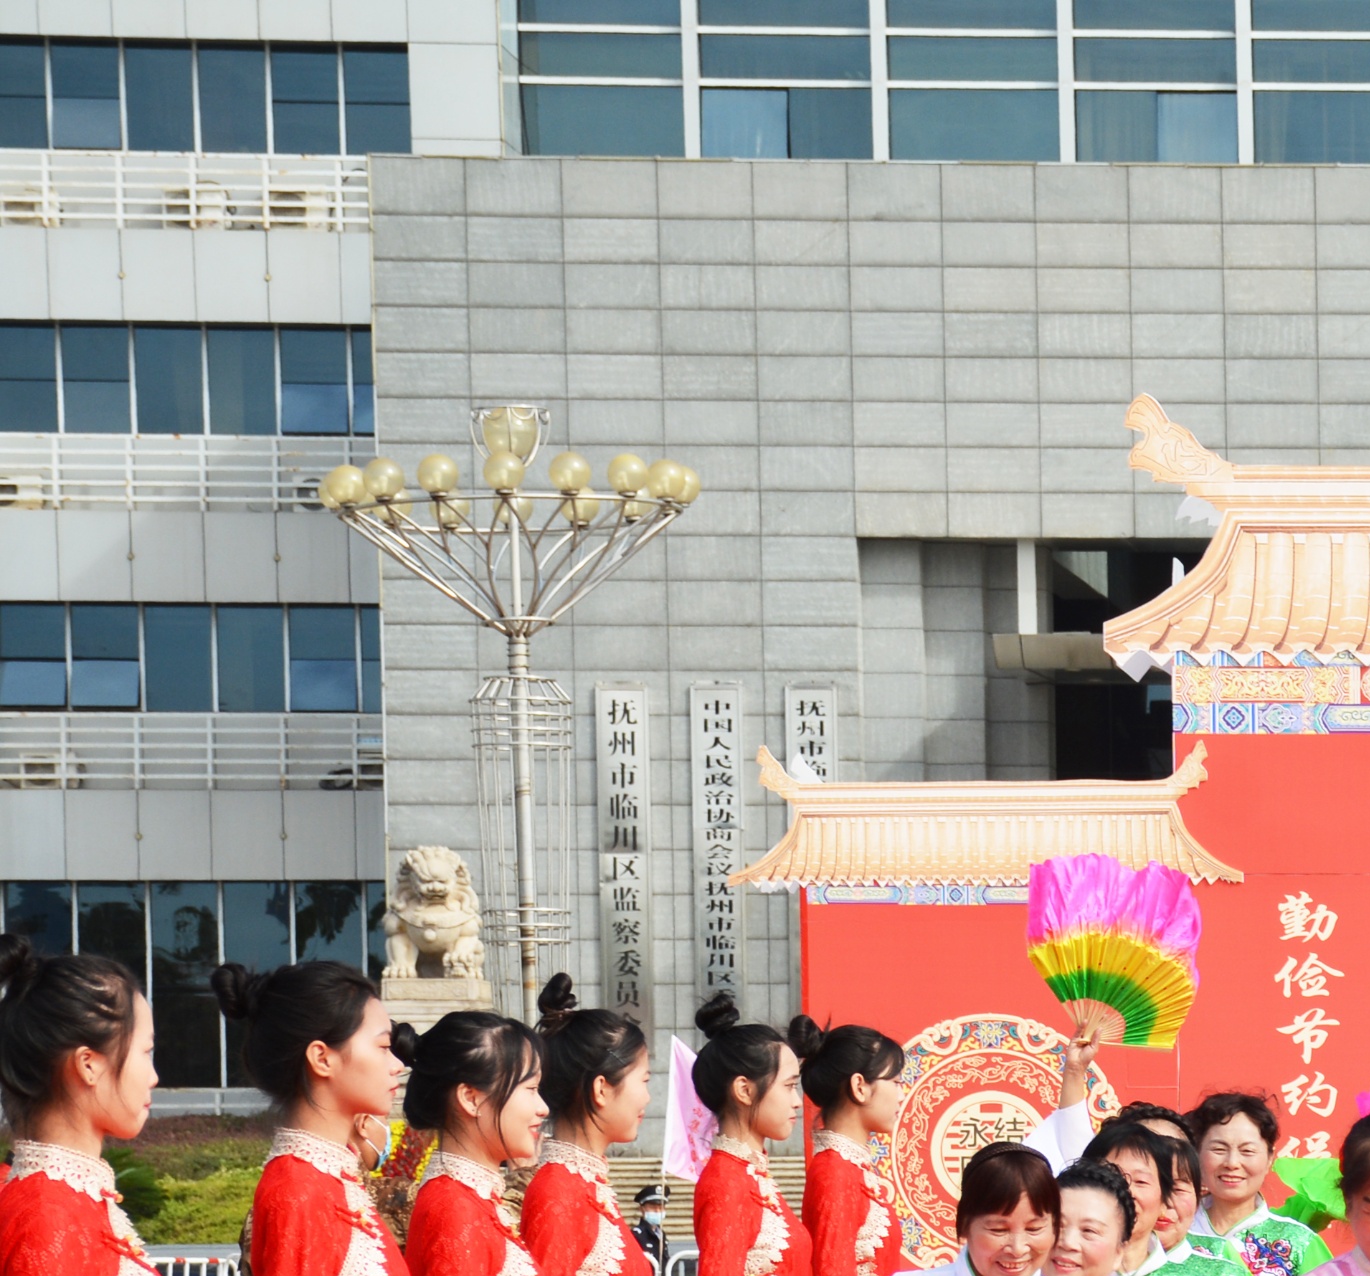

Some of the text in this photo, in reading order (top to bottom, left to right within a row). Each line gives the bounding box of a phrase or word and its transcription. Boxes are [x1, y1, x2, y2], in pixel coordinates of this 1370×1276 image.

[703, 699, 736, 998] 中国人民政治协商会议抚州市临川区
[959, 1117, 1025, 1147] 永结
